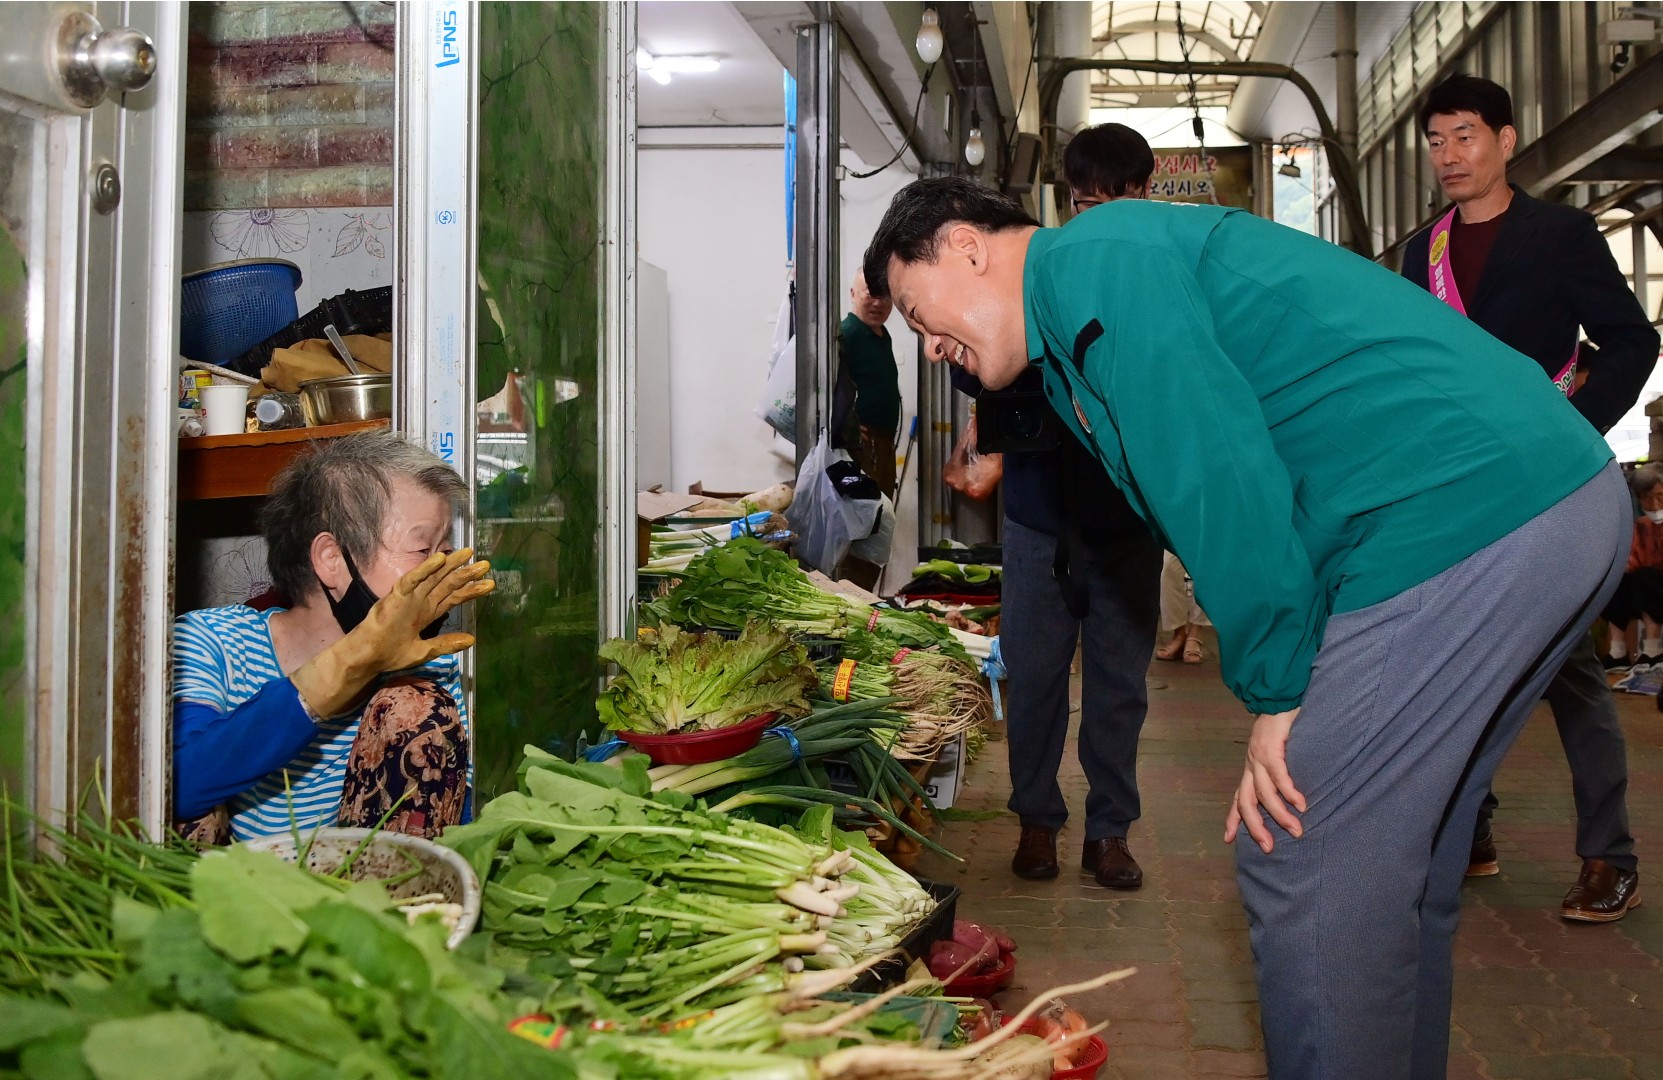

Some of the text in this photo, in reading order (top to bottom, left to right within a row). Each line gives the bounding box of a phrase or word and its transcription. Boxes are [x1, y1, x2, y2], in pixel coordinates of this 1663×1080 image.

[443, 11, 457, 57] PNS
[1150, 180, 1209, 197] 오십시오
[440, 432, 453, 464] NS
